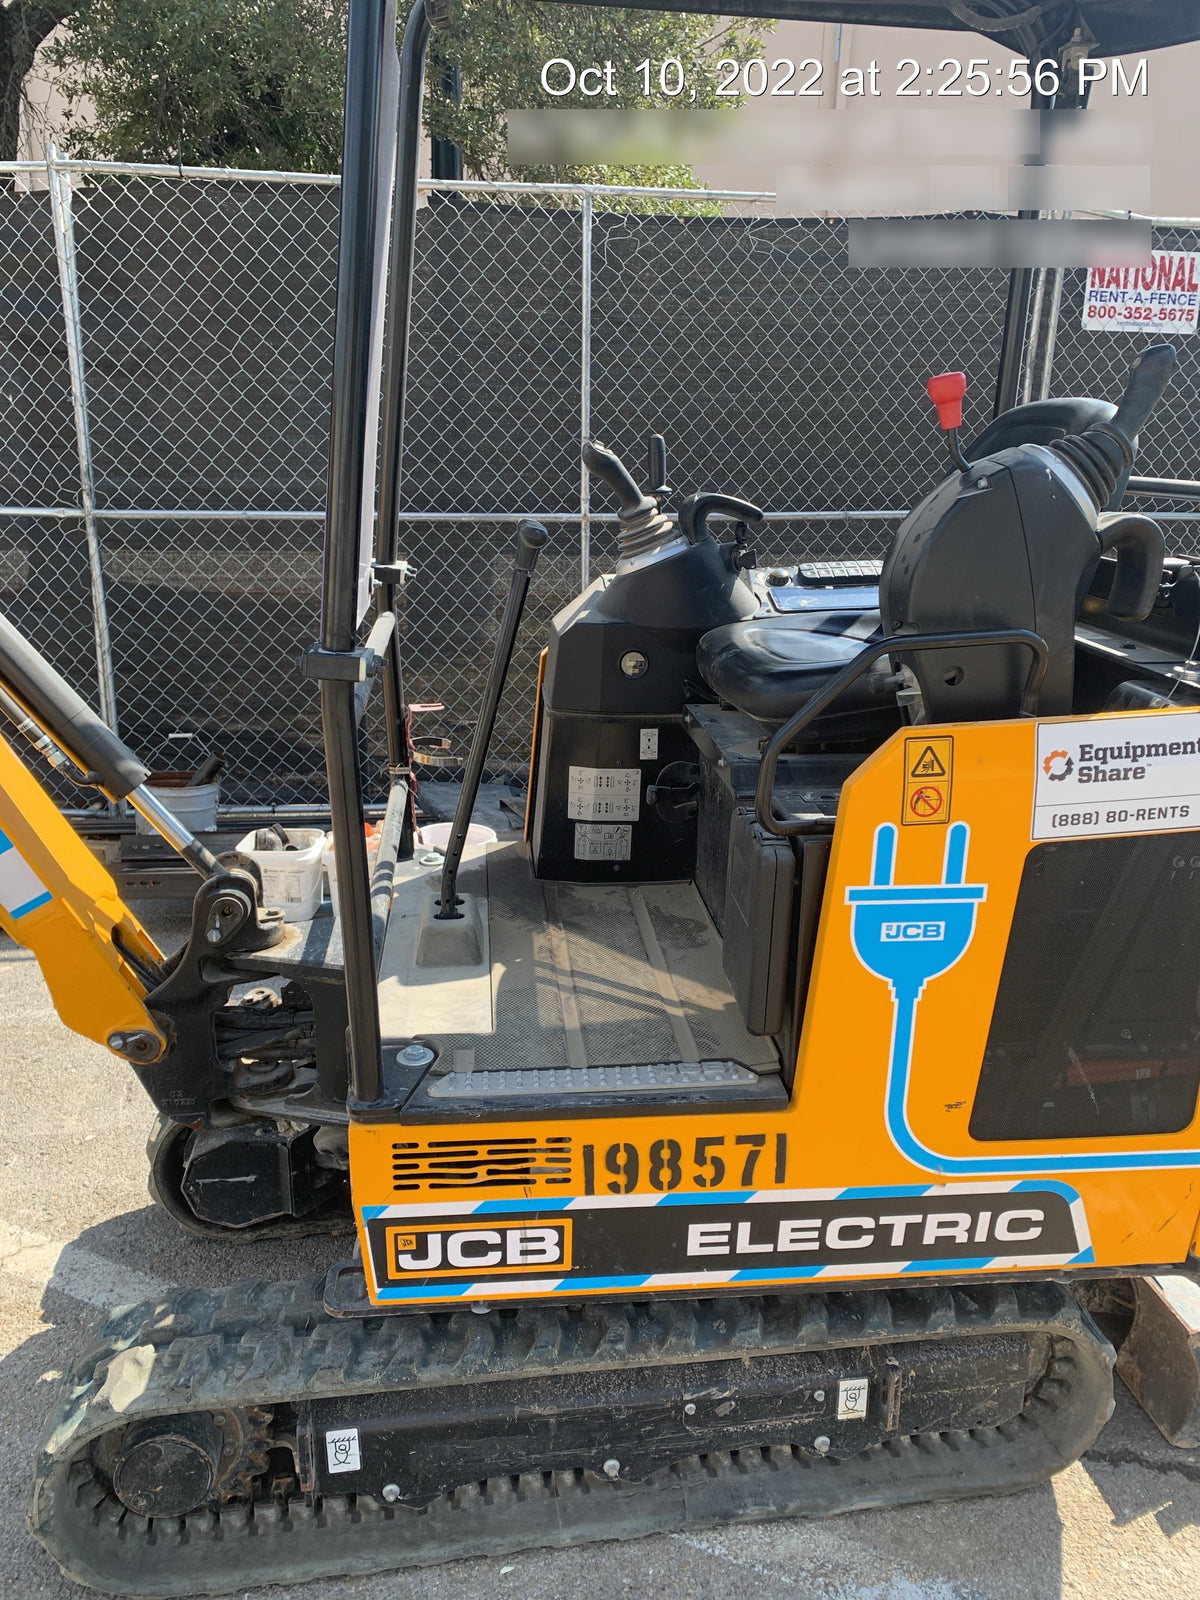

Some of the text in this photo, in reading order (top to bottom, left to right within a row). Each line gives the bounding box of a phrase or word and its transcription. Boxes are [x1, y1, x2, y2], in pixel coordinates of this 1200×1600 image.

[1088, 290, 1197, 306] RENT-A-FENCE
[1087, 305, 1195, 322] 800-352-5675
[1079, 738, 1200, 765] Equipment
[1052, 805, 1190, 828] (888) 80-RENTS
[885, 924, 942, 939] JCB
[687, 1209, 1045, 1256] ELECTRIC
[398, 1228, 560, 1271] JCB
